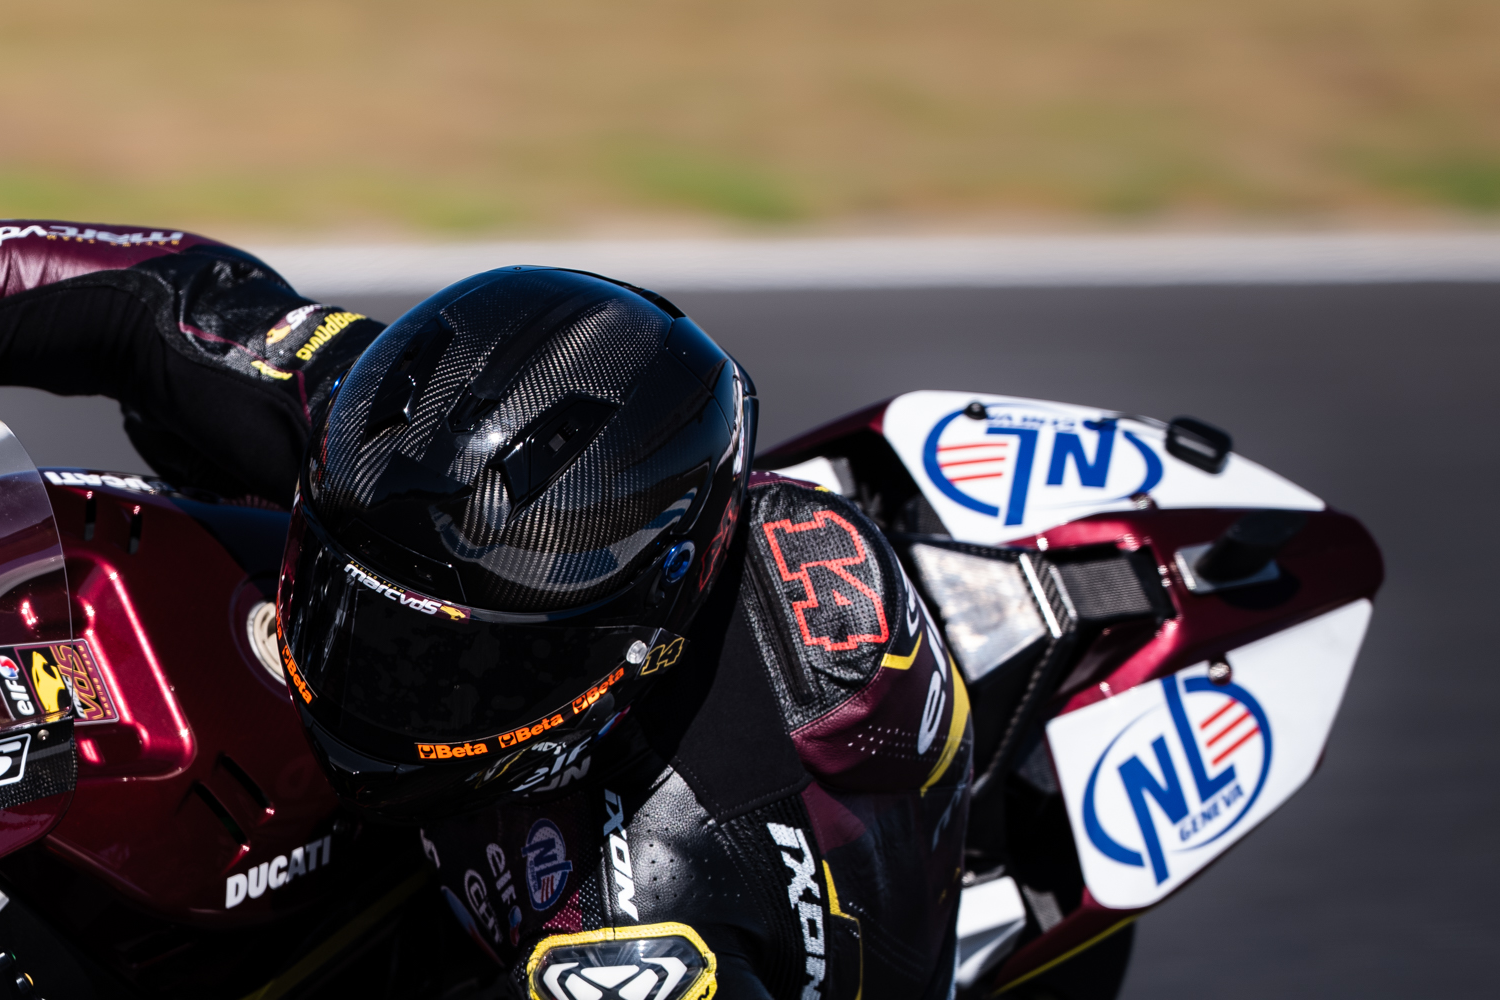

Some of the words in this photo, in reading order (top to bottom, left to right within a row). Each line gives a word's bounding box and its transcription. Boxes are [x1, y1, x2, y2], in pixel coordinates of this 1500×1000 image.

[984, 418, 1118, 526] NL
[343, 563, 443, 615] marcvds
[349, 560, 378, 580] RACING
[383, 580, 405, 593] TEAM
[763, 509, 889, 652] 14
[286, 657, 313, 705] Beta
[640, 636, 685, 676] 14
[5, 679, 36, 716] elf
[585, 667, 625, 701] Beta
[434, 742, 489, 759] Beta
[515, 713, 565, 743] Beta
[1118, 676, 1236, 886] NL
[1178, 784, 1246, 842] GENEVA
[226, 835, 333, 909] DUCATI
[521, 837, 573, 892] NL
[603, 788, 640, 922] IXON
